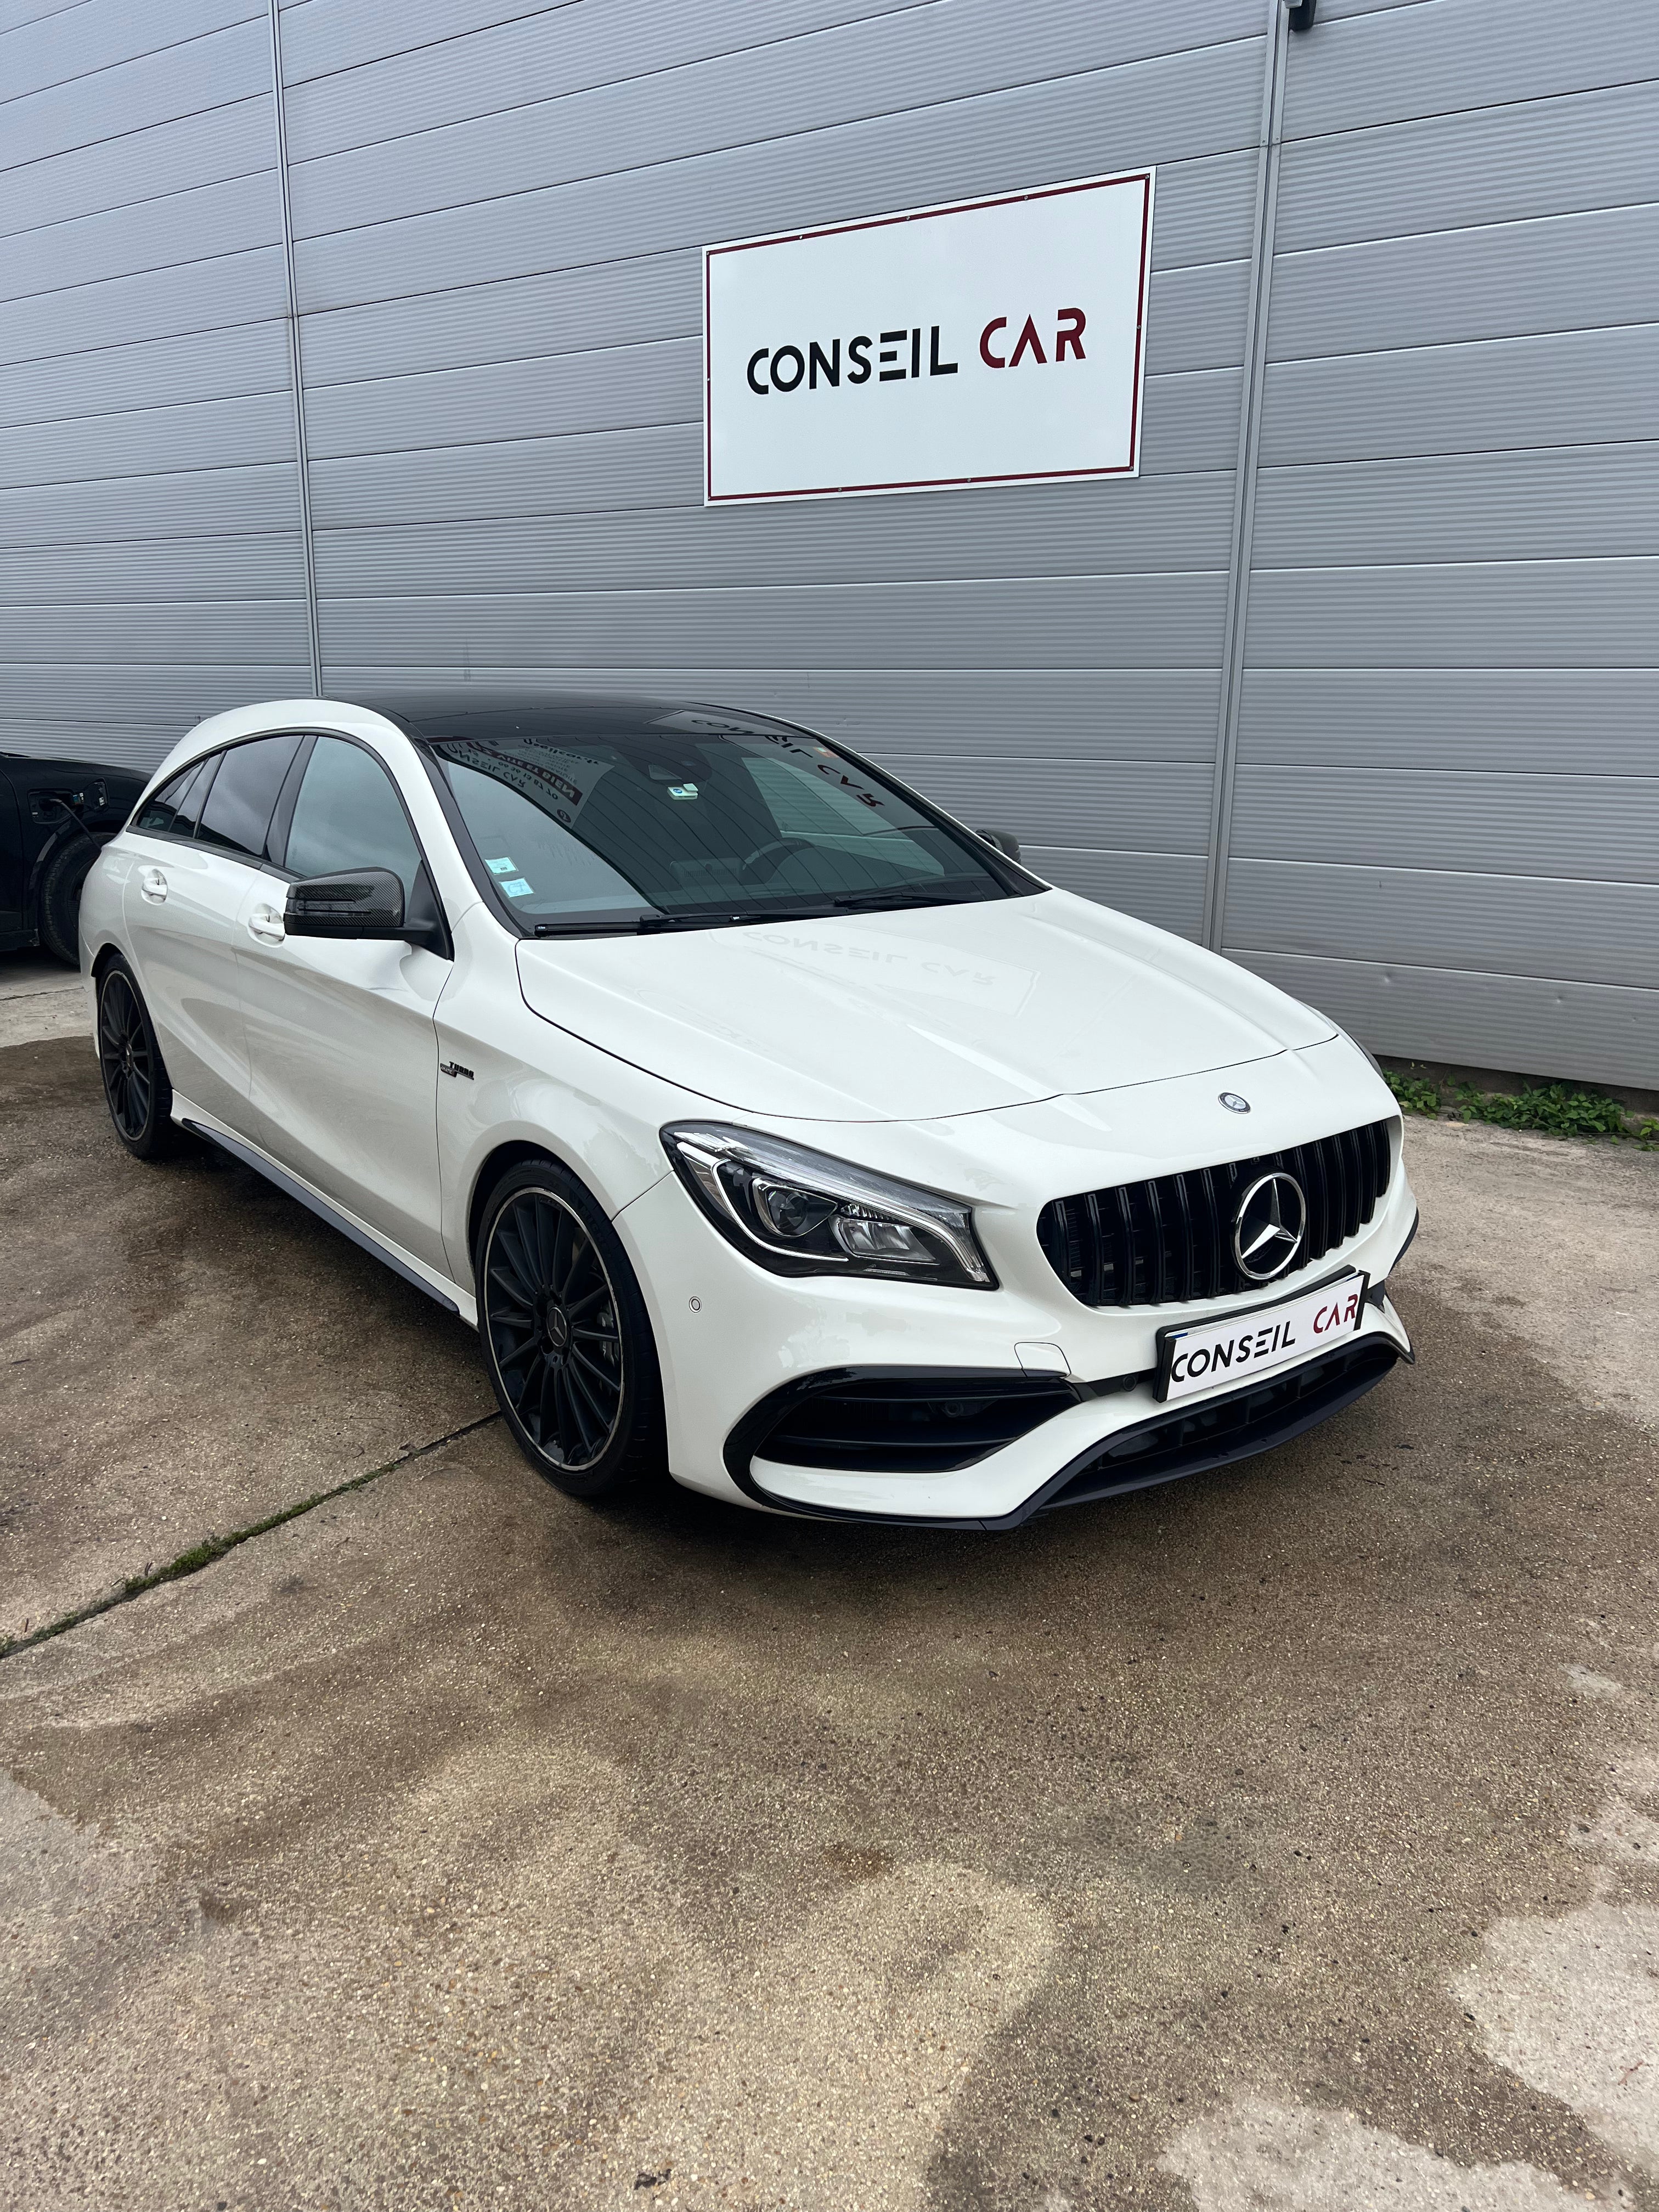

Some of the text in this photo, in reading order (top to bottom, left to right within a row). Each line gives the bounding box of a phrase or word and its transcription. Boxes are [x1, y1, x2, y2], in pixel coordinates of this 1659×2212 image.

[747, 307, 1086, 395] CONSEIL CAR
[1171, 1294, 1358, 1383] CONSEIL CAR
